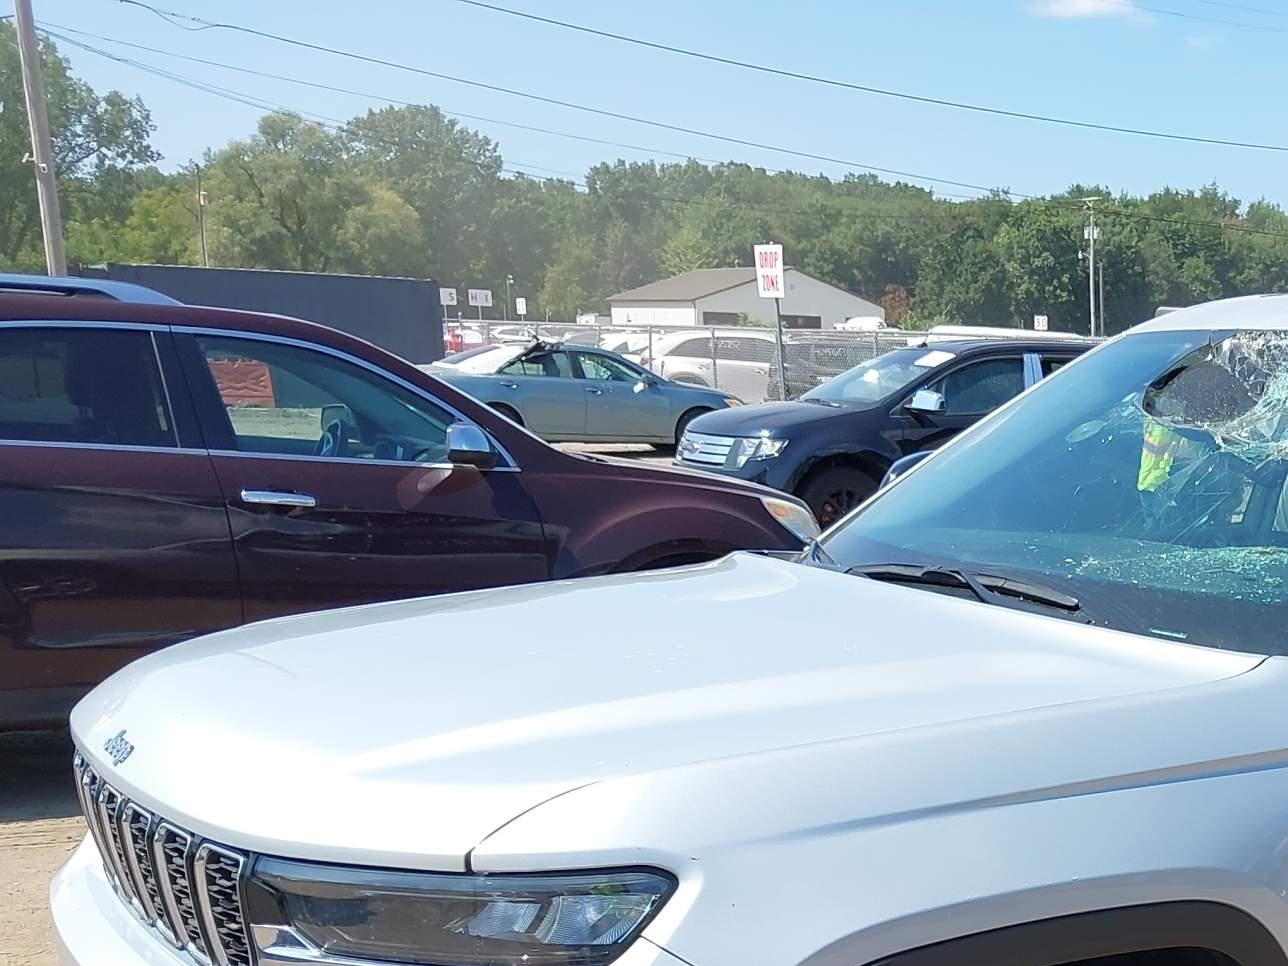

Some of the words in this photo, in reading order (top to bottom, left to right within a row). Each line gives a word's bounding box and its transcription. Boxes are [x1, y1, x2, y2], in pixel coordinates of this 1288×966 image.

[759, 251, 779, 269] DROP
[762, 274, 780, 292] ZONE
[448, 292, 455, 302] S
